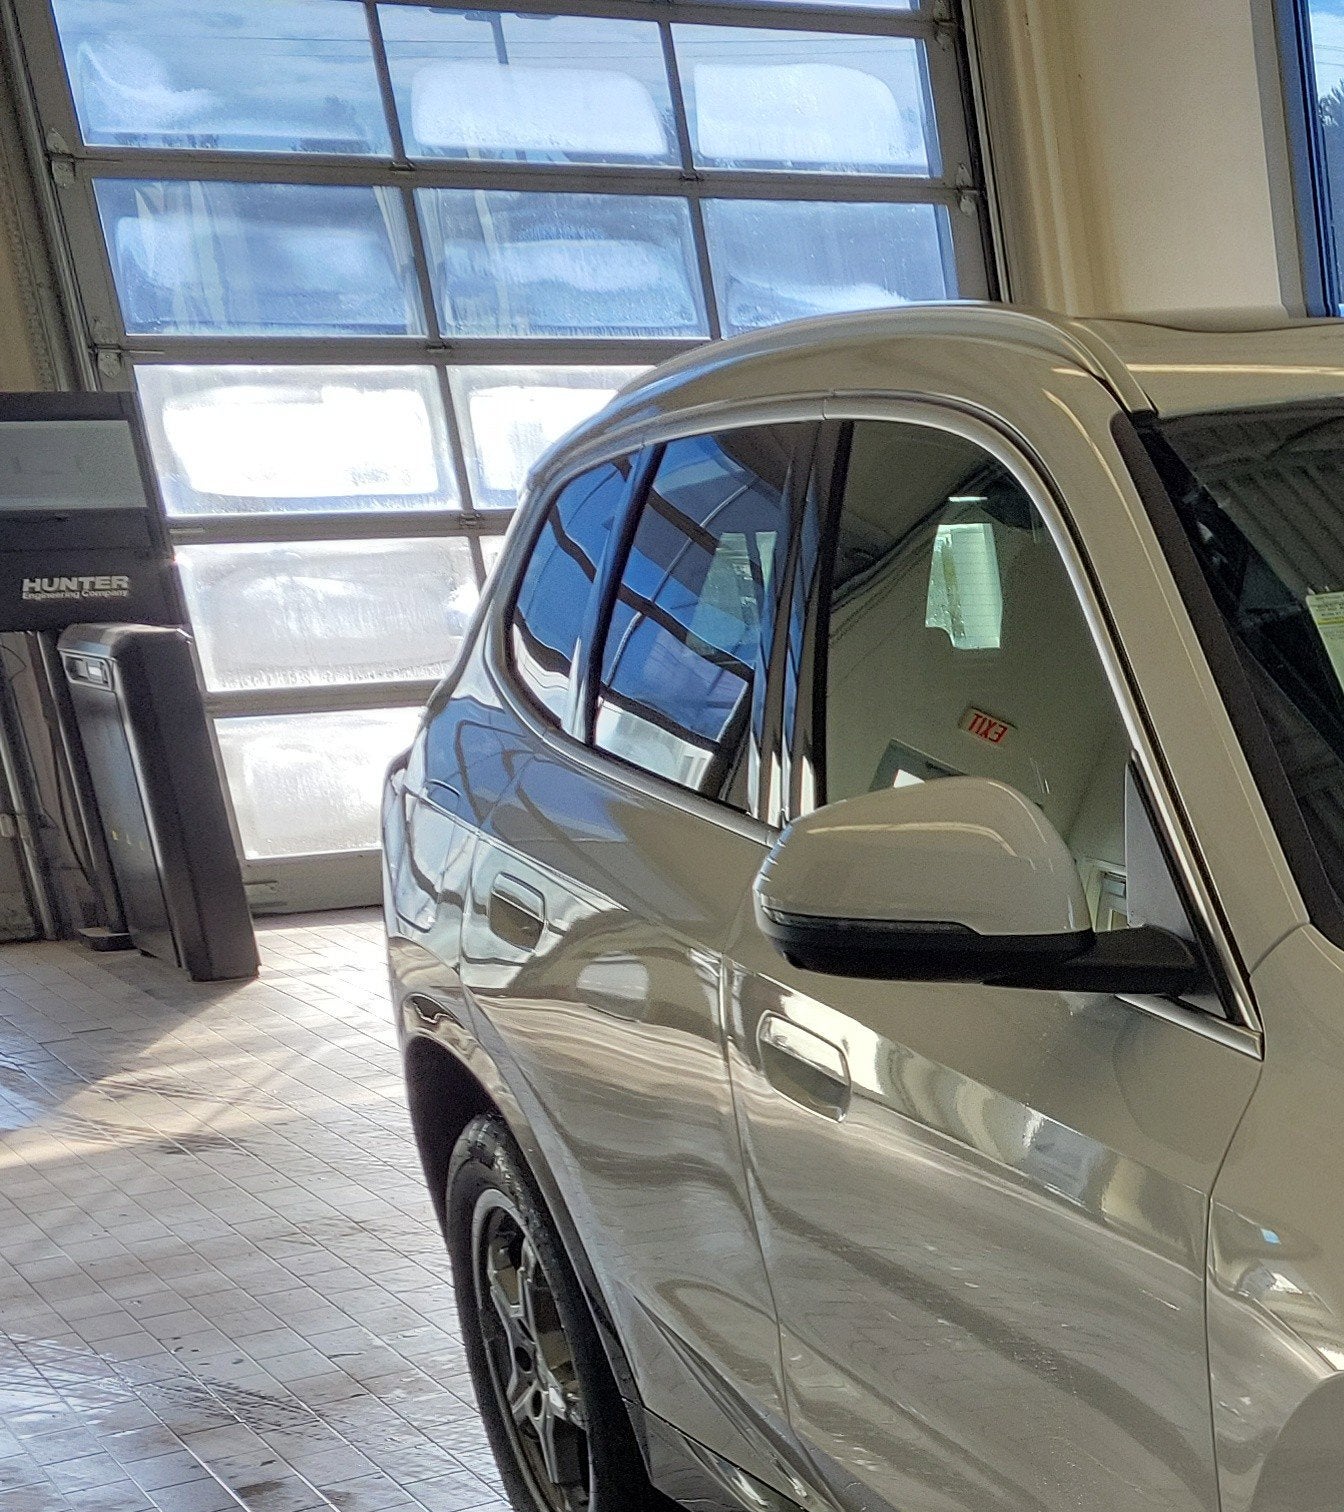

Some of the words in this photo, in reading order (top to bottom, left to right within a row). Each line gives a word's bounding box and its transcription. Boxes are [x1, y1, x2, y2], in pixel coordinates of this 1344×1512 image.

[22, 576, 129, 592] HUNTER
[22, 591, 80, 601] Engineering
[81, 590, 128, 598] Company
